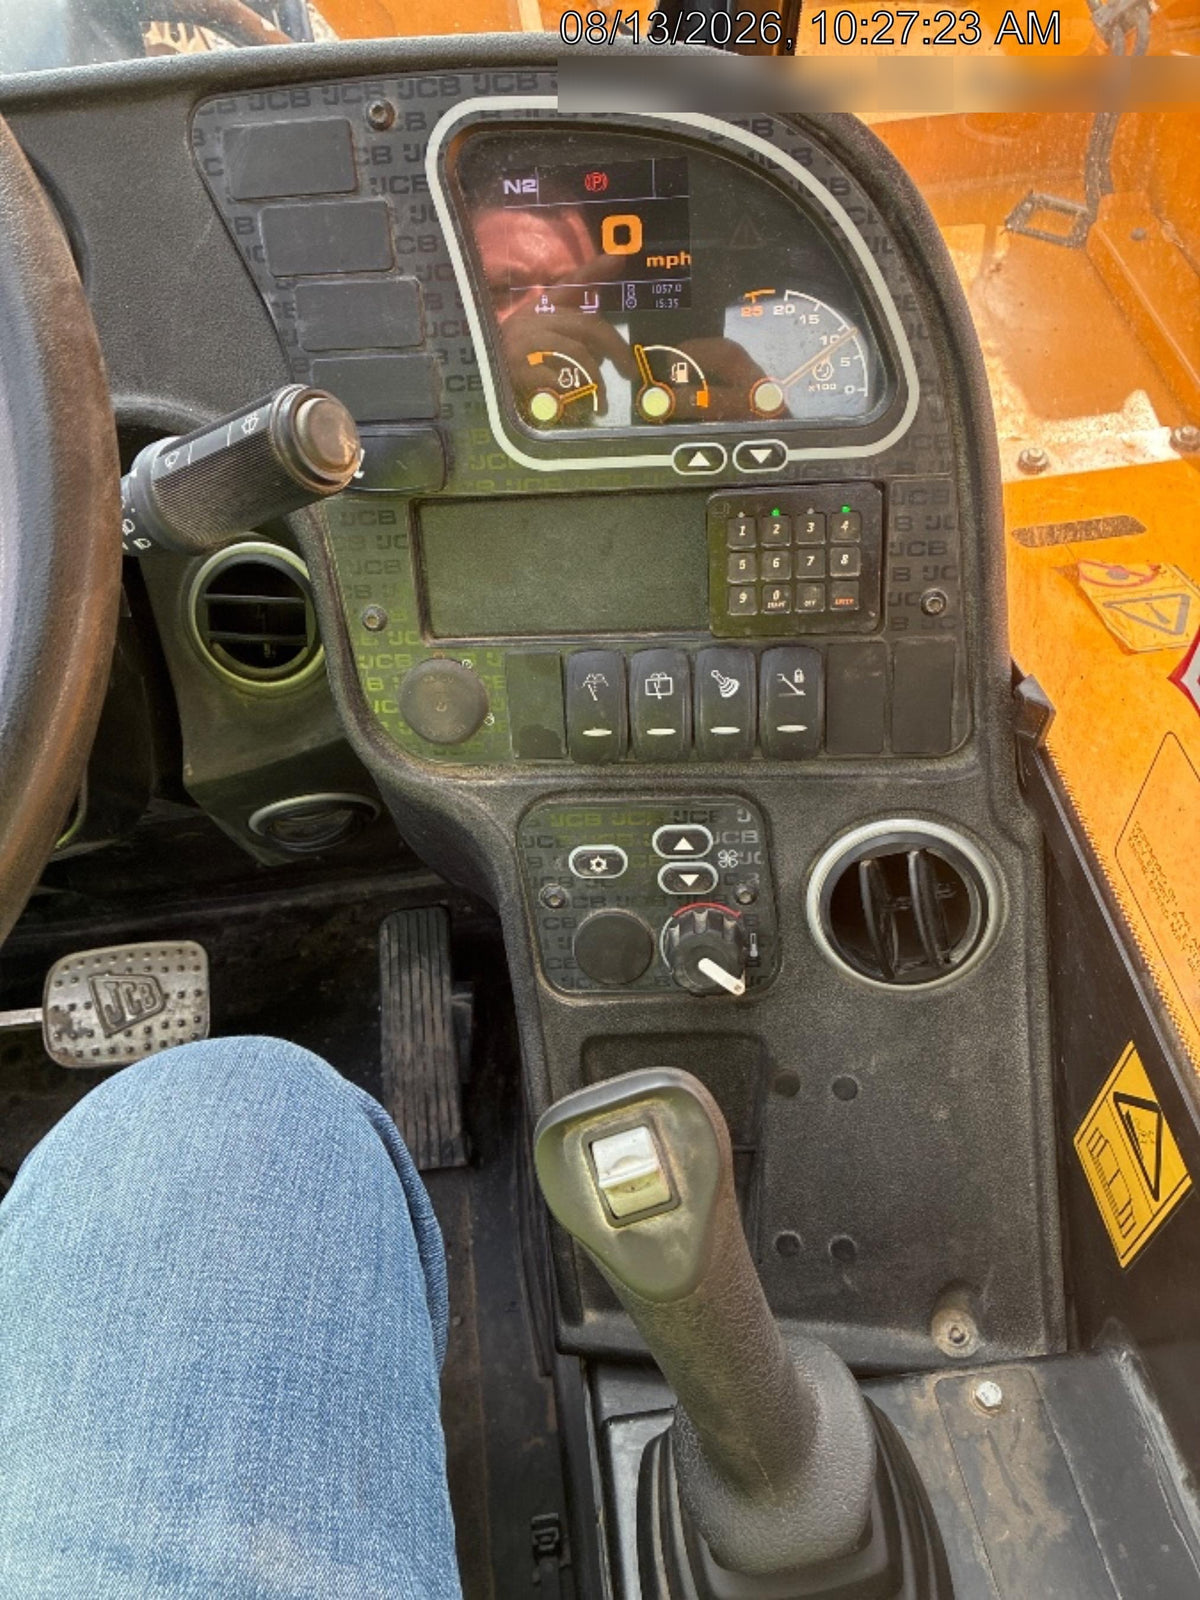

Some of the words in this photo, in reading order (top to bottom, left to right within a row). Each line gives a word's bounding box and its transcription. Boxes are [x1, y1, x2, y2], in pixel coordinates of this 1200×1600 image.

[250, 90, 311, 111] JCB
[397, 76, 461, 99] JCB
[472, 73, 538, 94] JCB
[503, 178, 538, 195] N2
[601, 214, 643, 256] 0
[395, 234, 438, 254] CB
[646, 251, 691, 269] mph
[773, 304, 796, 316] 20
[799, 313, 821, 325] 15
[819, 333, 841, 346] 10
[840, 356, 851, 368] 5
[844, 384, 855, 395] 0
[738, 526, 747, 536] 1
[773, 524, 781, 534] 2
[807, 522, 815, 532] 3
[841, 520, 849, 531] 4
[925, 515, 957, 531] JC
[376, 535, 408, 549] JC
[890, 541, 947, 556] JCB
[738, 559, 747, 570] 5
[772, 557, 781, 568] 6
[806, 556, 815, 566] 7
[840, 554, 848, 565] 8
[923, 565, 958, 581] JC
[739, 592, 748, 603] 9
[773, 590, 780, 600] 0
[888, 591, 921, 607] JC
[921, 614, 957, 630] JC
[388, 631, 420, 646] JC
[358, 654, 413, 669] JCB
[372, 699, 400, 714] JC
[550, 813, 602, 827] JCB
[542, 916, 576, 930] CB
[545, 956, 577, 970] CB
[103, 981, 157, 1026] JCB
